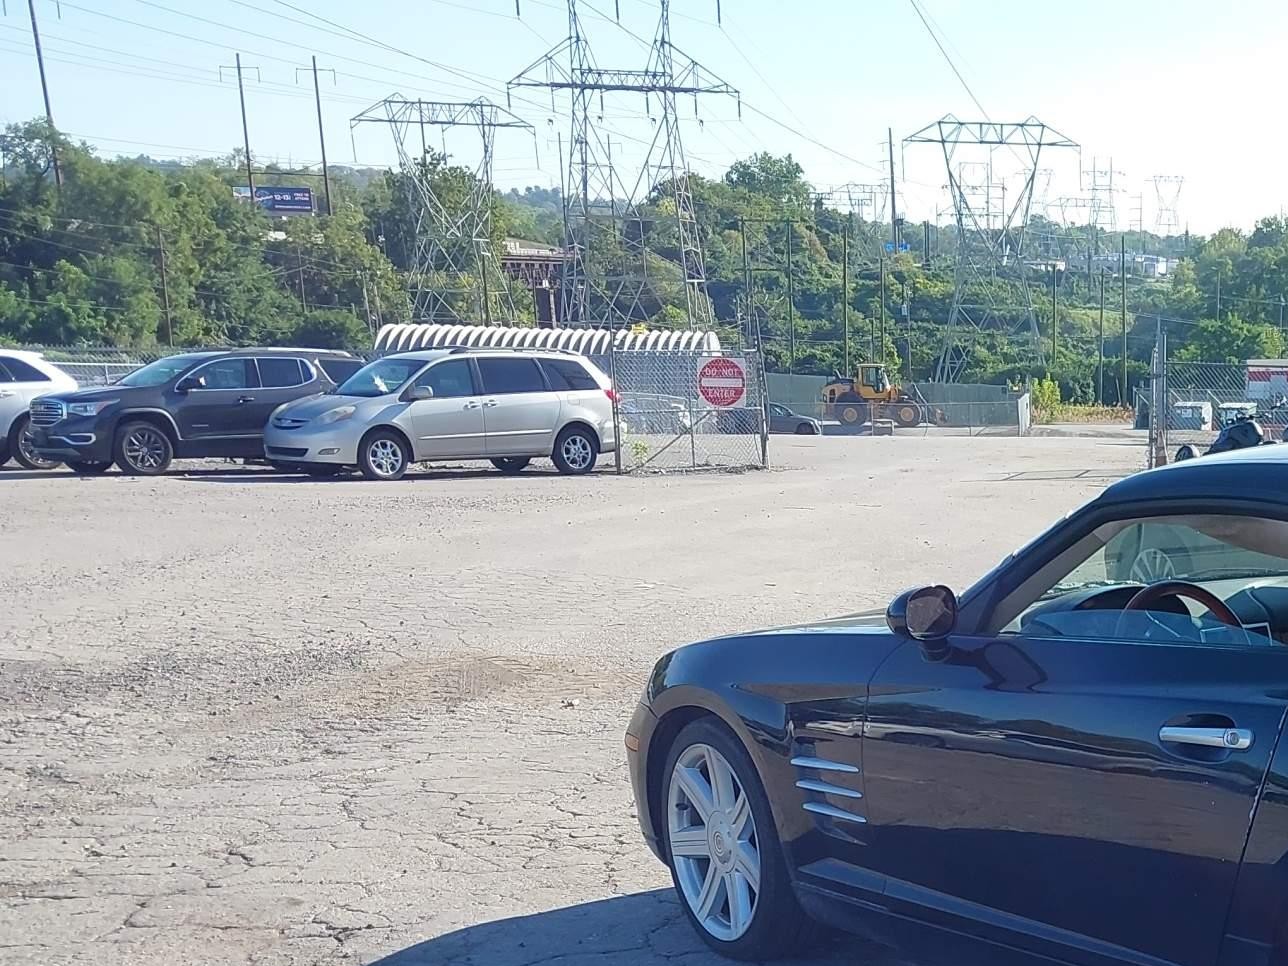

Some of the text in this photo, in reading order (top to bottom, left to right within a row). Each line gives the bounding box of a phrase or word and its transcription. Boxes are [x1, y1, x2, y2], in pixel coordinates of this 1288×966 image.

[705, 367, 738, 376] DO NOT
[708, 389, 735, 398] ENTER
